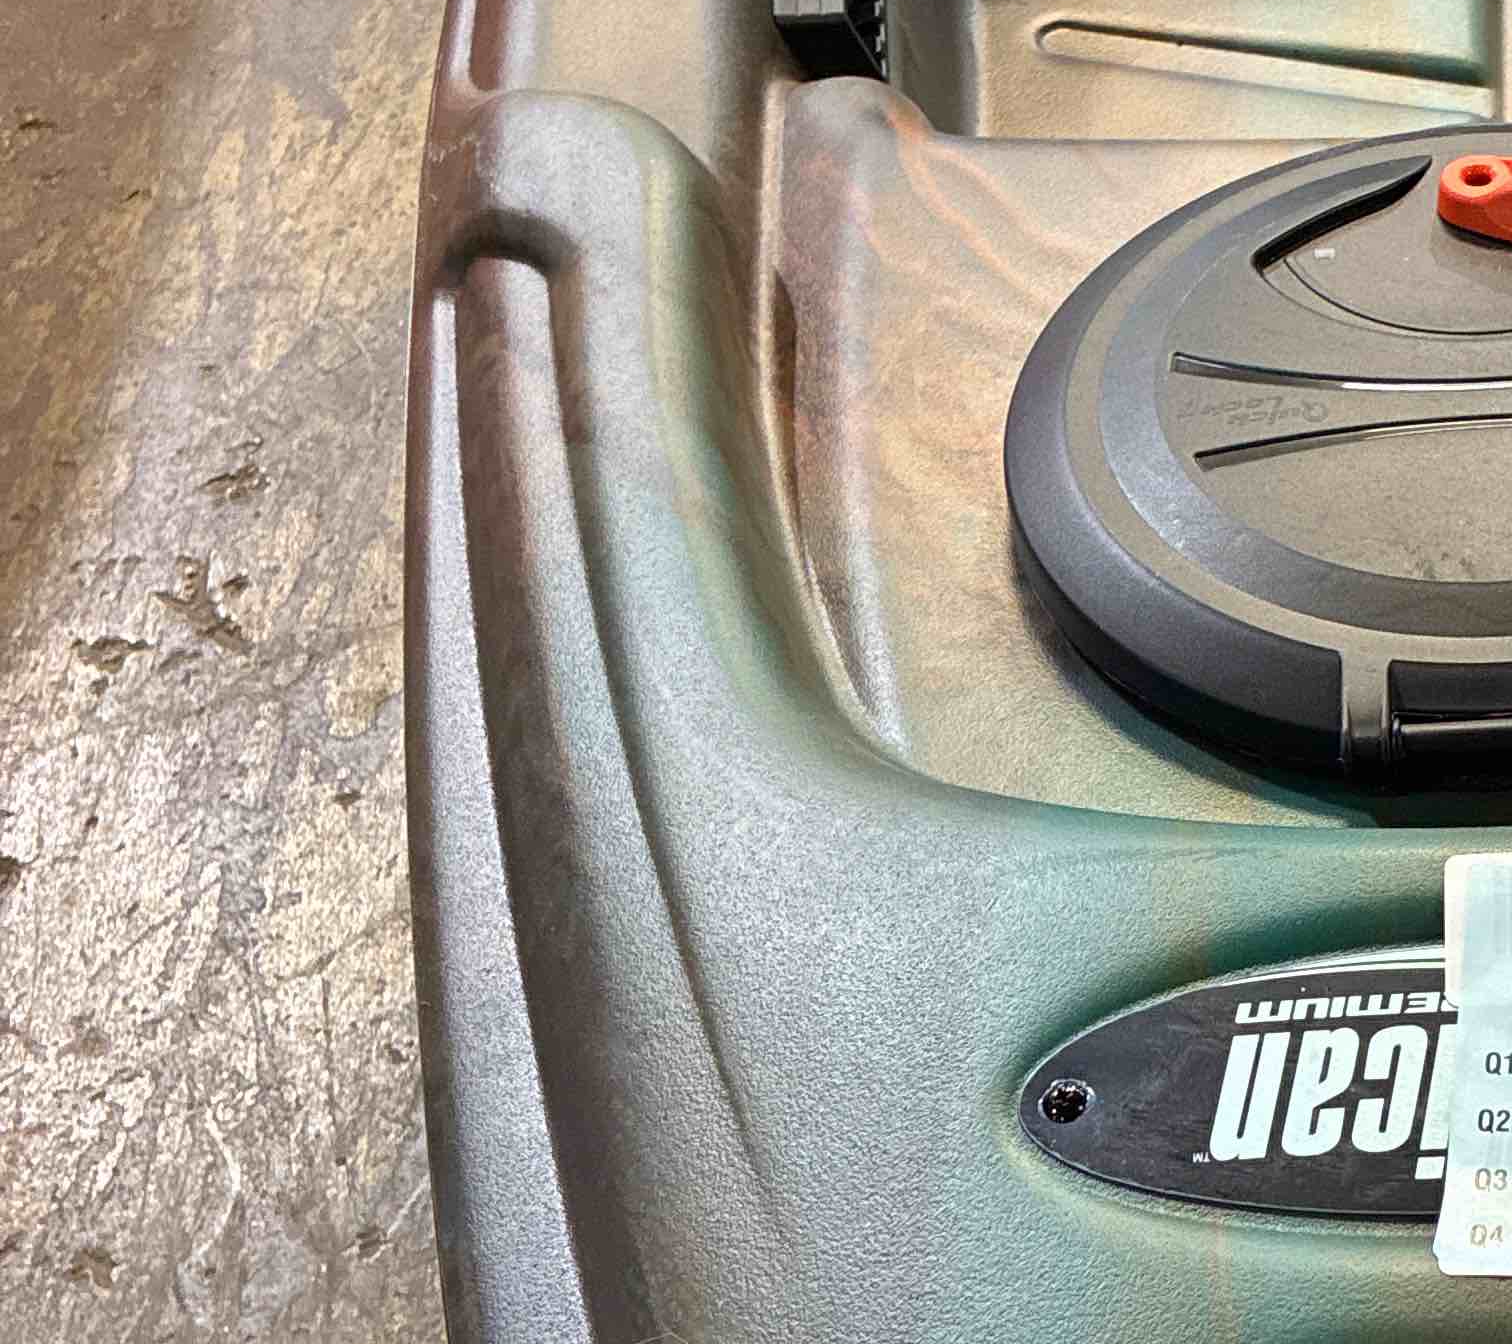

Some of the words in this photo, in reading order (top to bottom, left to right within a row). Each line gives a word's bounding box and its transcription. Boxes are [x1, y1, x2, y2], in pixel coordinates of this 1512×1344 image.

[1235, 992, 1457, 1024] EMIUM
[1209, 1024, 1458, 1180] ican
[1478, 1109, 1511, 1132] Q2
[1474, 1168, 1509, 1192] Q3
[1470, 1224, 1504, 1247] Q4
